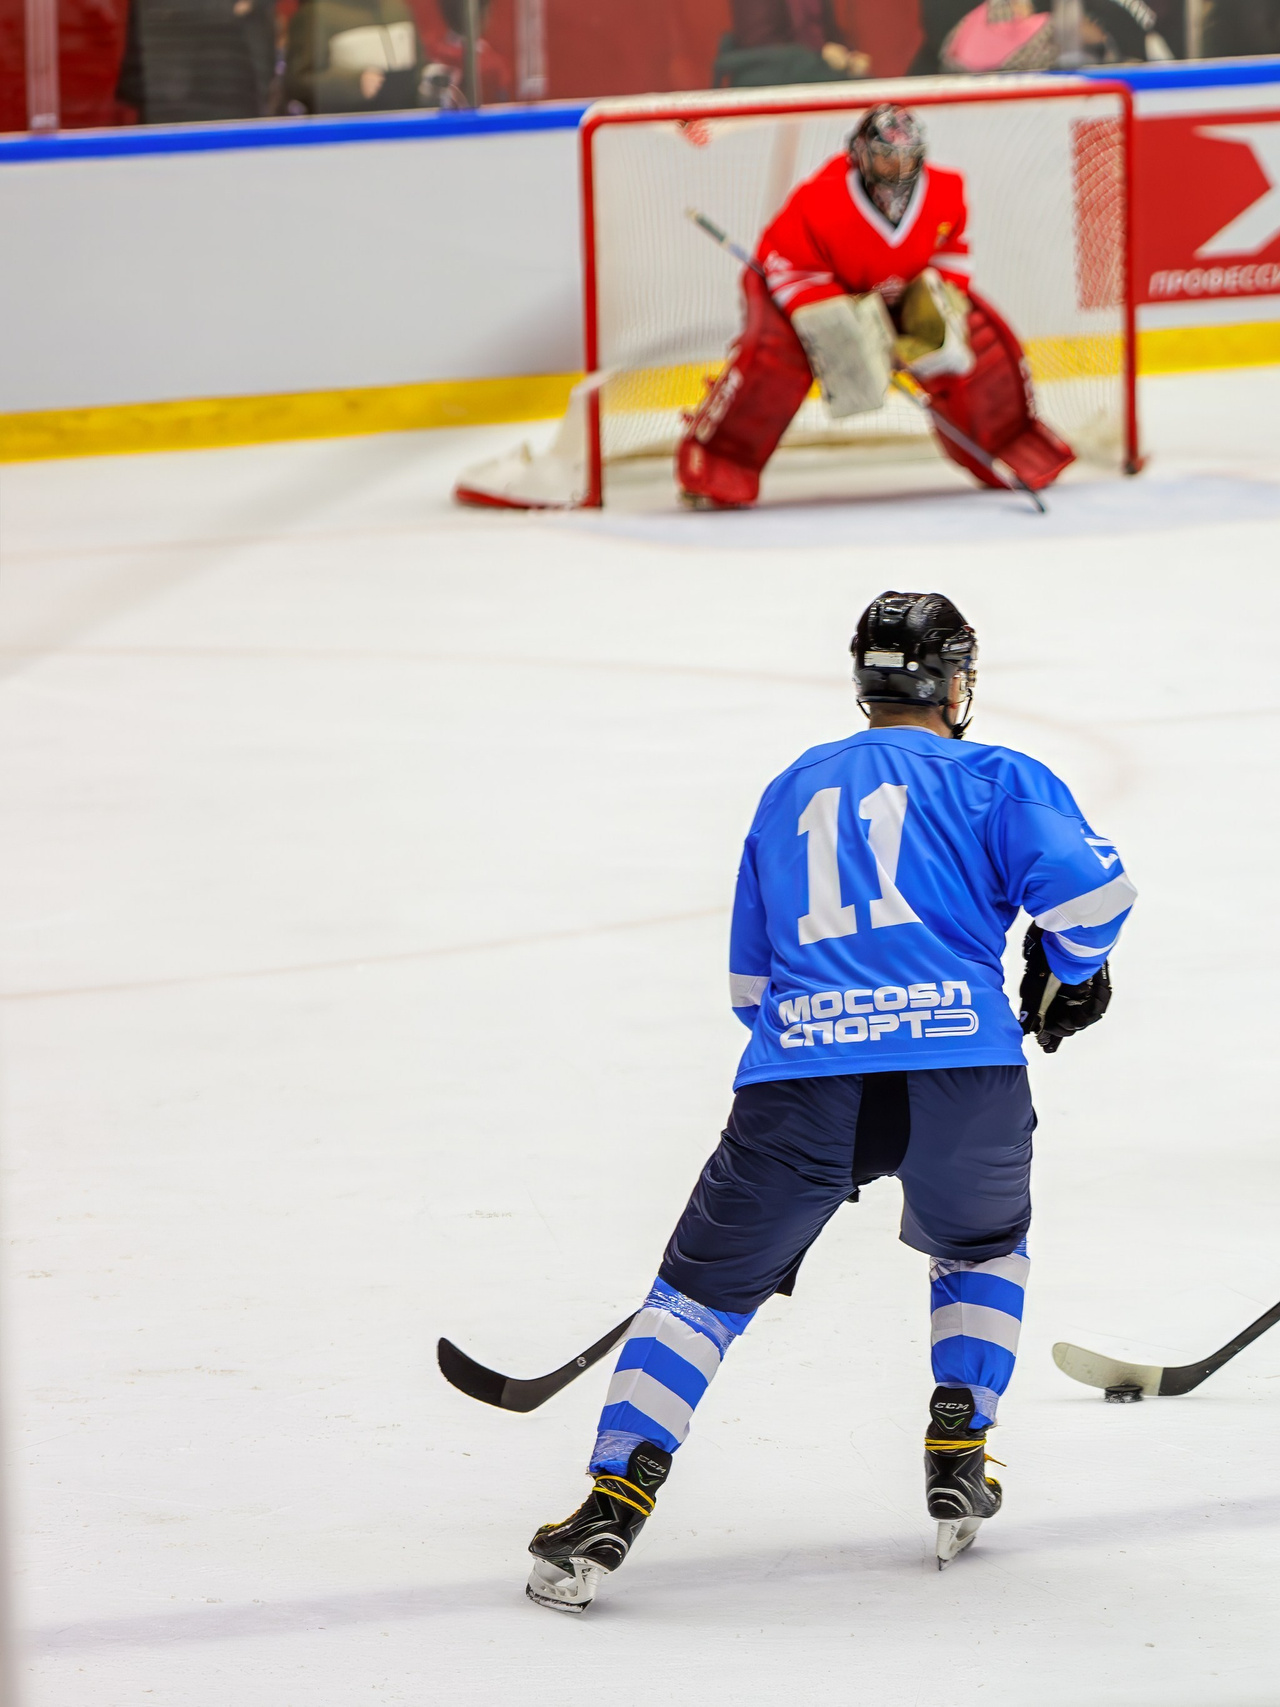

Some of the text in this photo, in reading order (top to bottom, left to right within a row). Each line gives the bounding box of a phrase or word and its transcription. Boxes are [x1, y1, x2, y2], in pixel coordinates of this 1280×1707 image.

[797, 782, 923, 946] 11
[778, 980, 972, 1027] МОСОБЛ
[779, 1010, 932, 1050] СПОРТ
[934, 1402, 970, 1411] CCM
